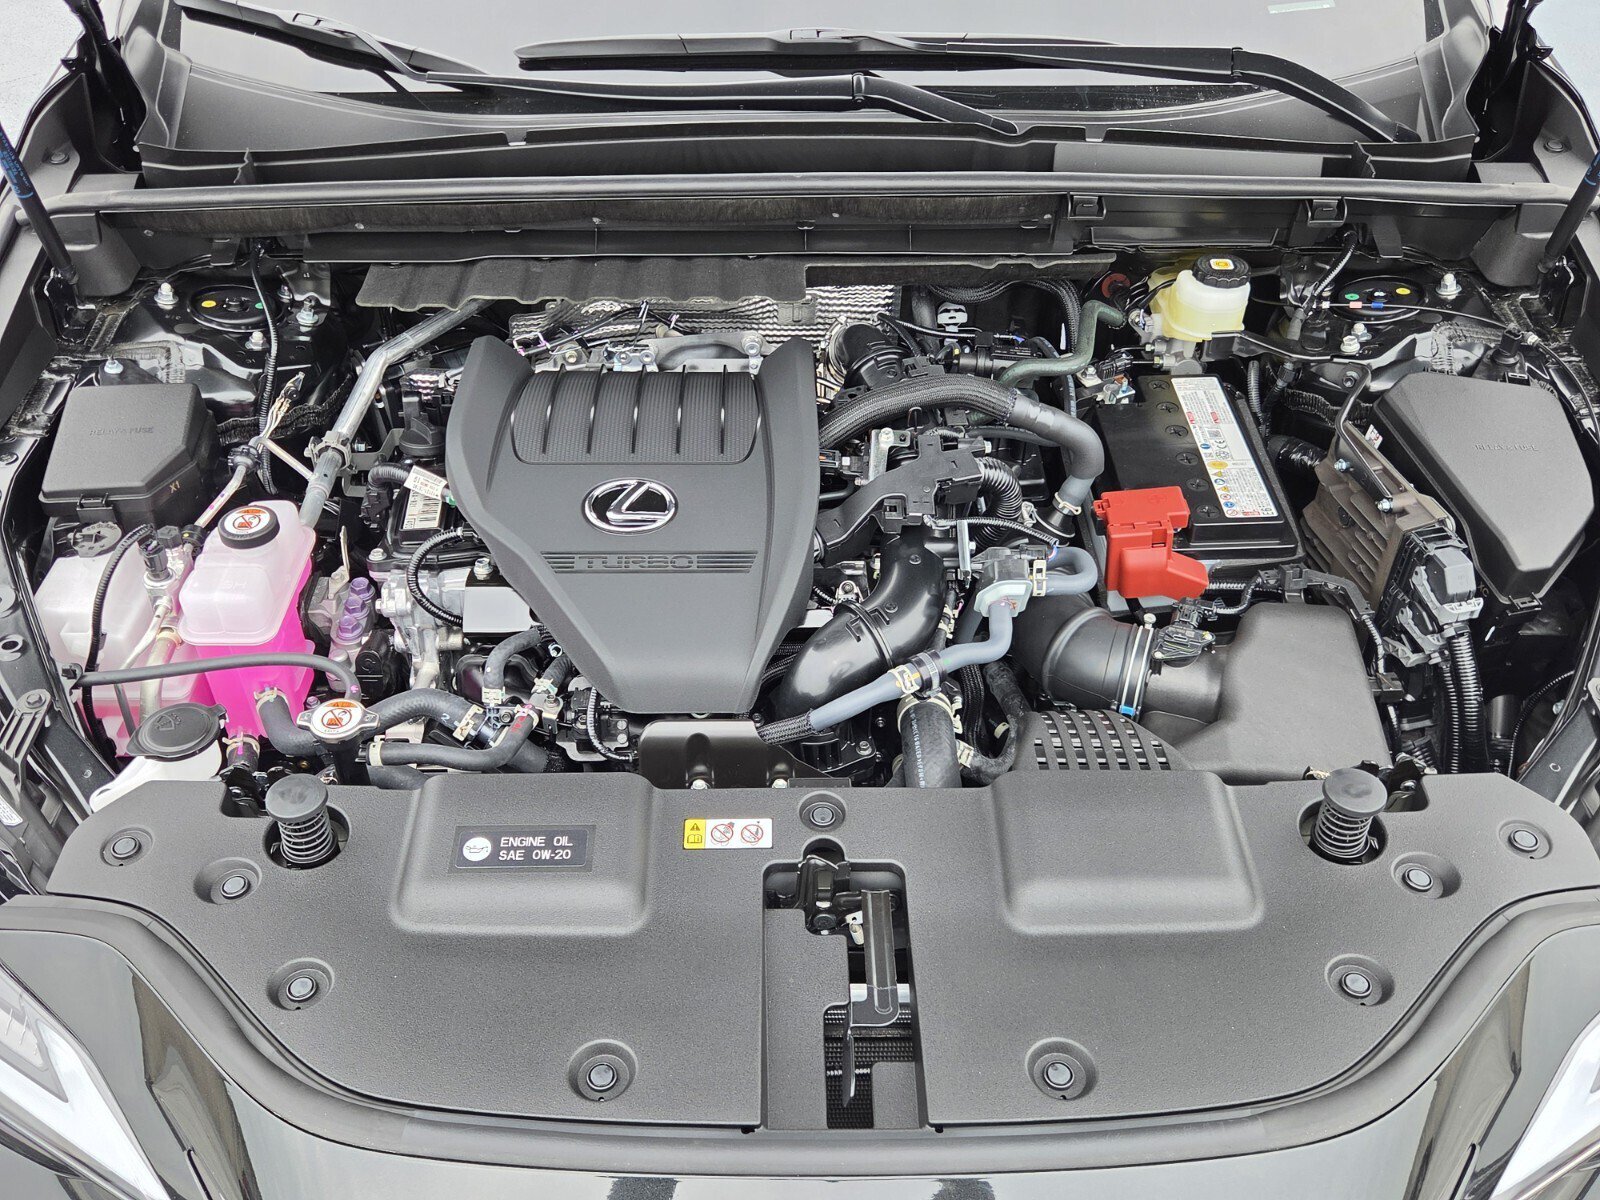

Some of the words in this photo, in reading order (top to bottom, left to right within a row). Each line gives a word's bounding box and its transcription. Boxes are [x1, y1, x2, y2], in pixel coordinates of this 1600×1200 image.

[578, 555, 693, 568] TURBO
[500, 837, 546, 847] ENGINE
[553, 836, 573, 846] OIL
[499, 850, 525, 860] SAE
[532, 849, 571, 860] 0W-20
